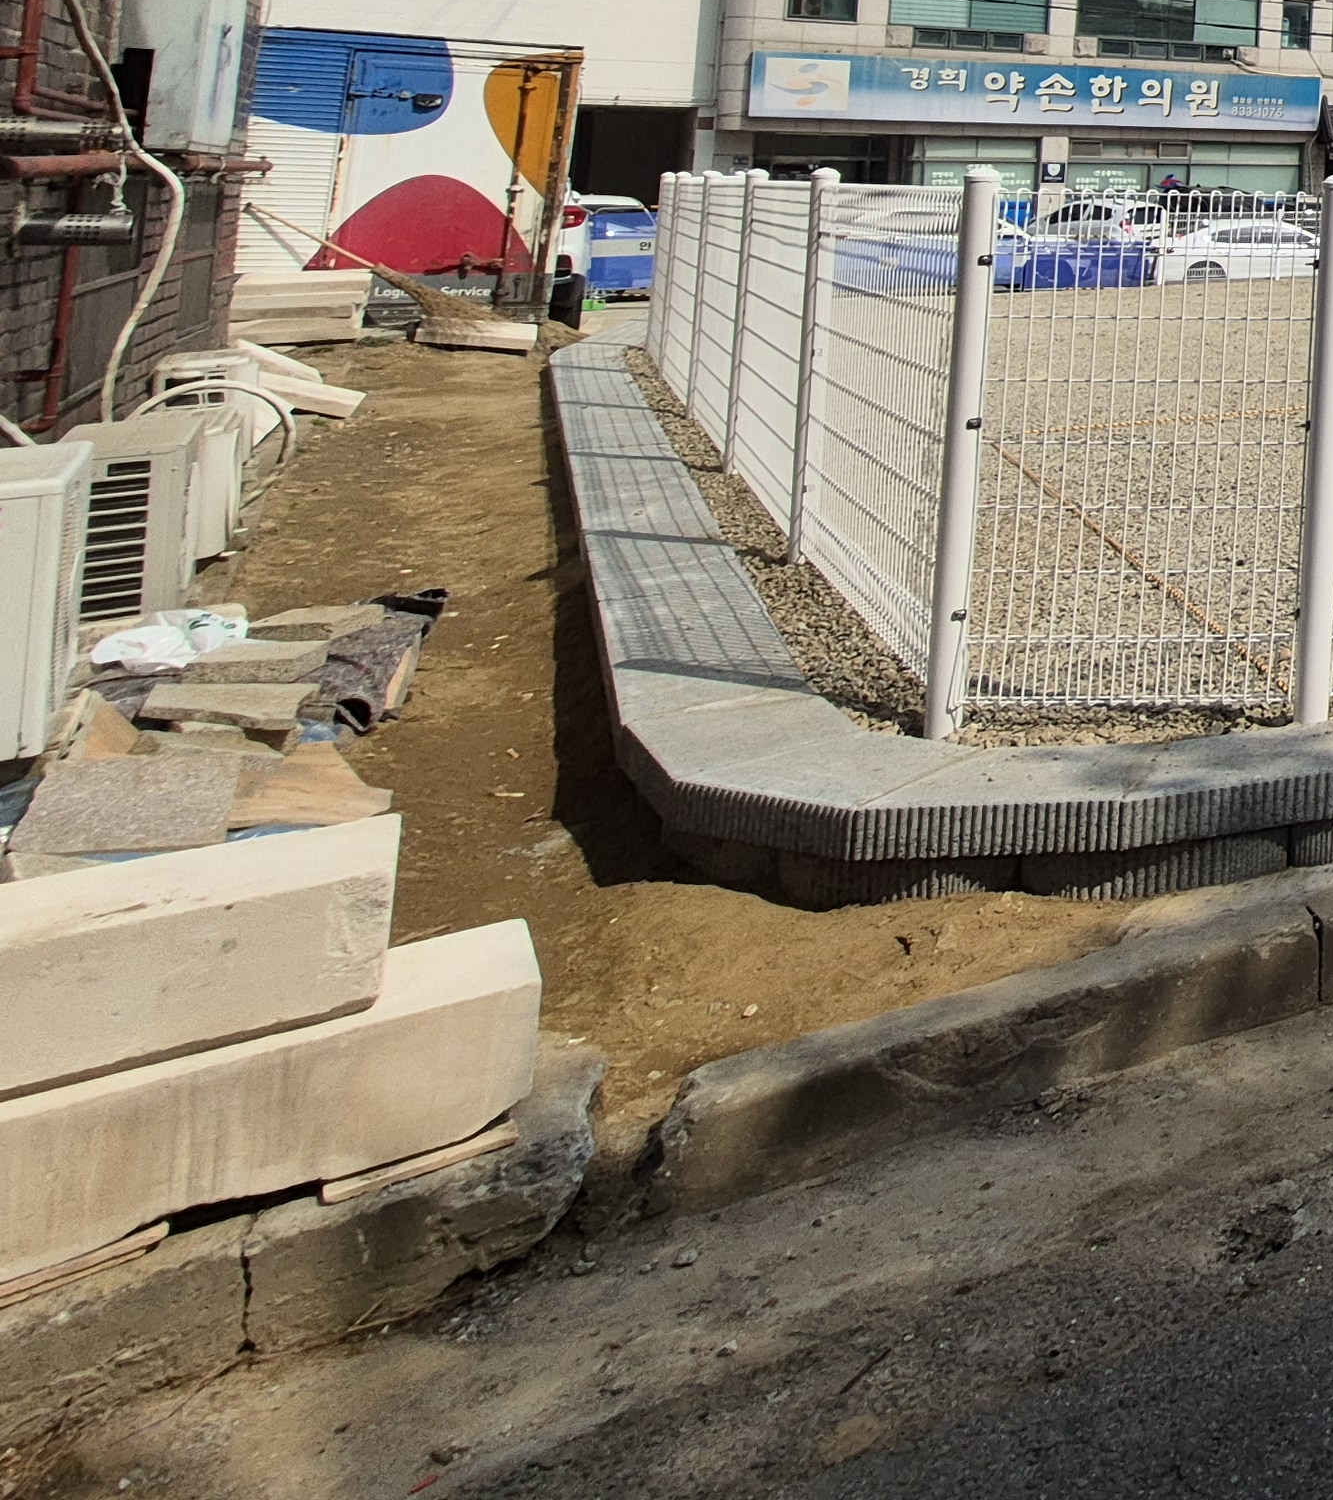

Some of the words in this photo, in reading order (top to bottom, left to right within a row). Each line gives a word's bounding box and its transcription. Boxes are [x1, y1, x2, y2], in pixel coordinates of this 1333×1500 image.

[901, 67, 968, 92] 경희
[983, 70, 1221, 118] 약손한의원
[440, 286, 492, 296] Service
